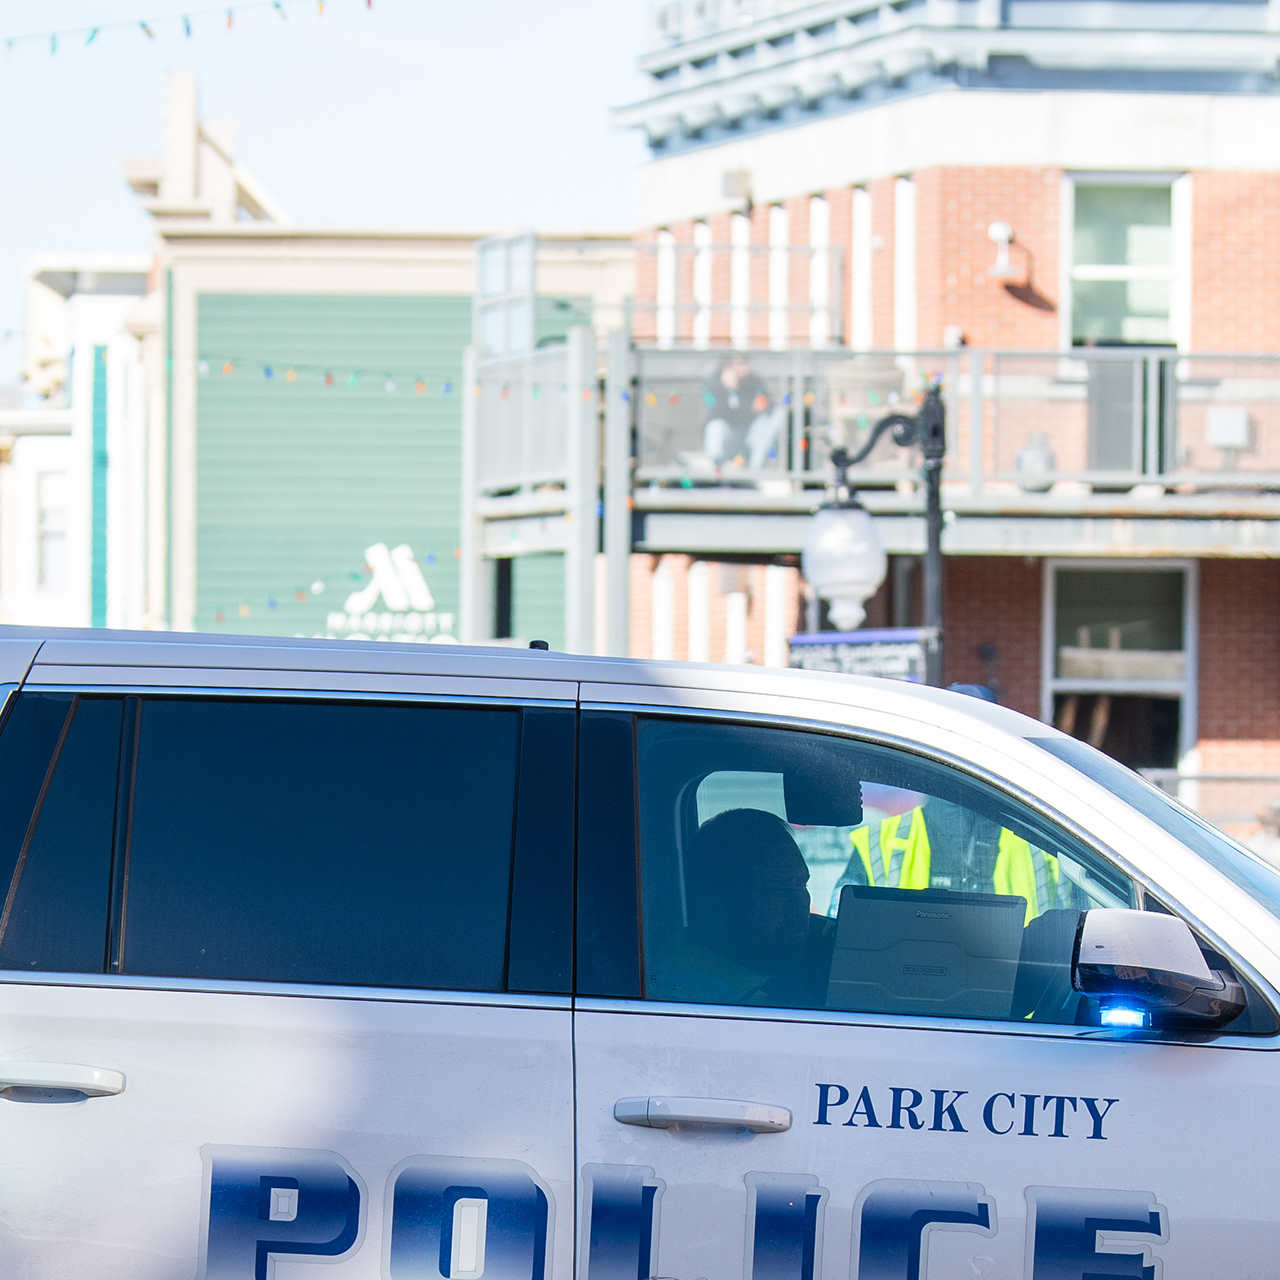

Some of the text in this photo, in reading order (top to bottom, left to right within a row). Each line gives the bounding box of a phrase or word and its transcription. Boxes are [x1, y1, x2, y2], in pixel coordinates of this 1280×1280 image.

[915, 909, 952, 920] Panasonic
[812, 1083, 1120, 1141] PARK CITY
